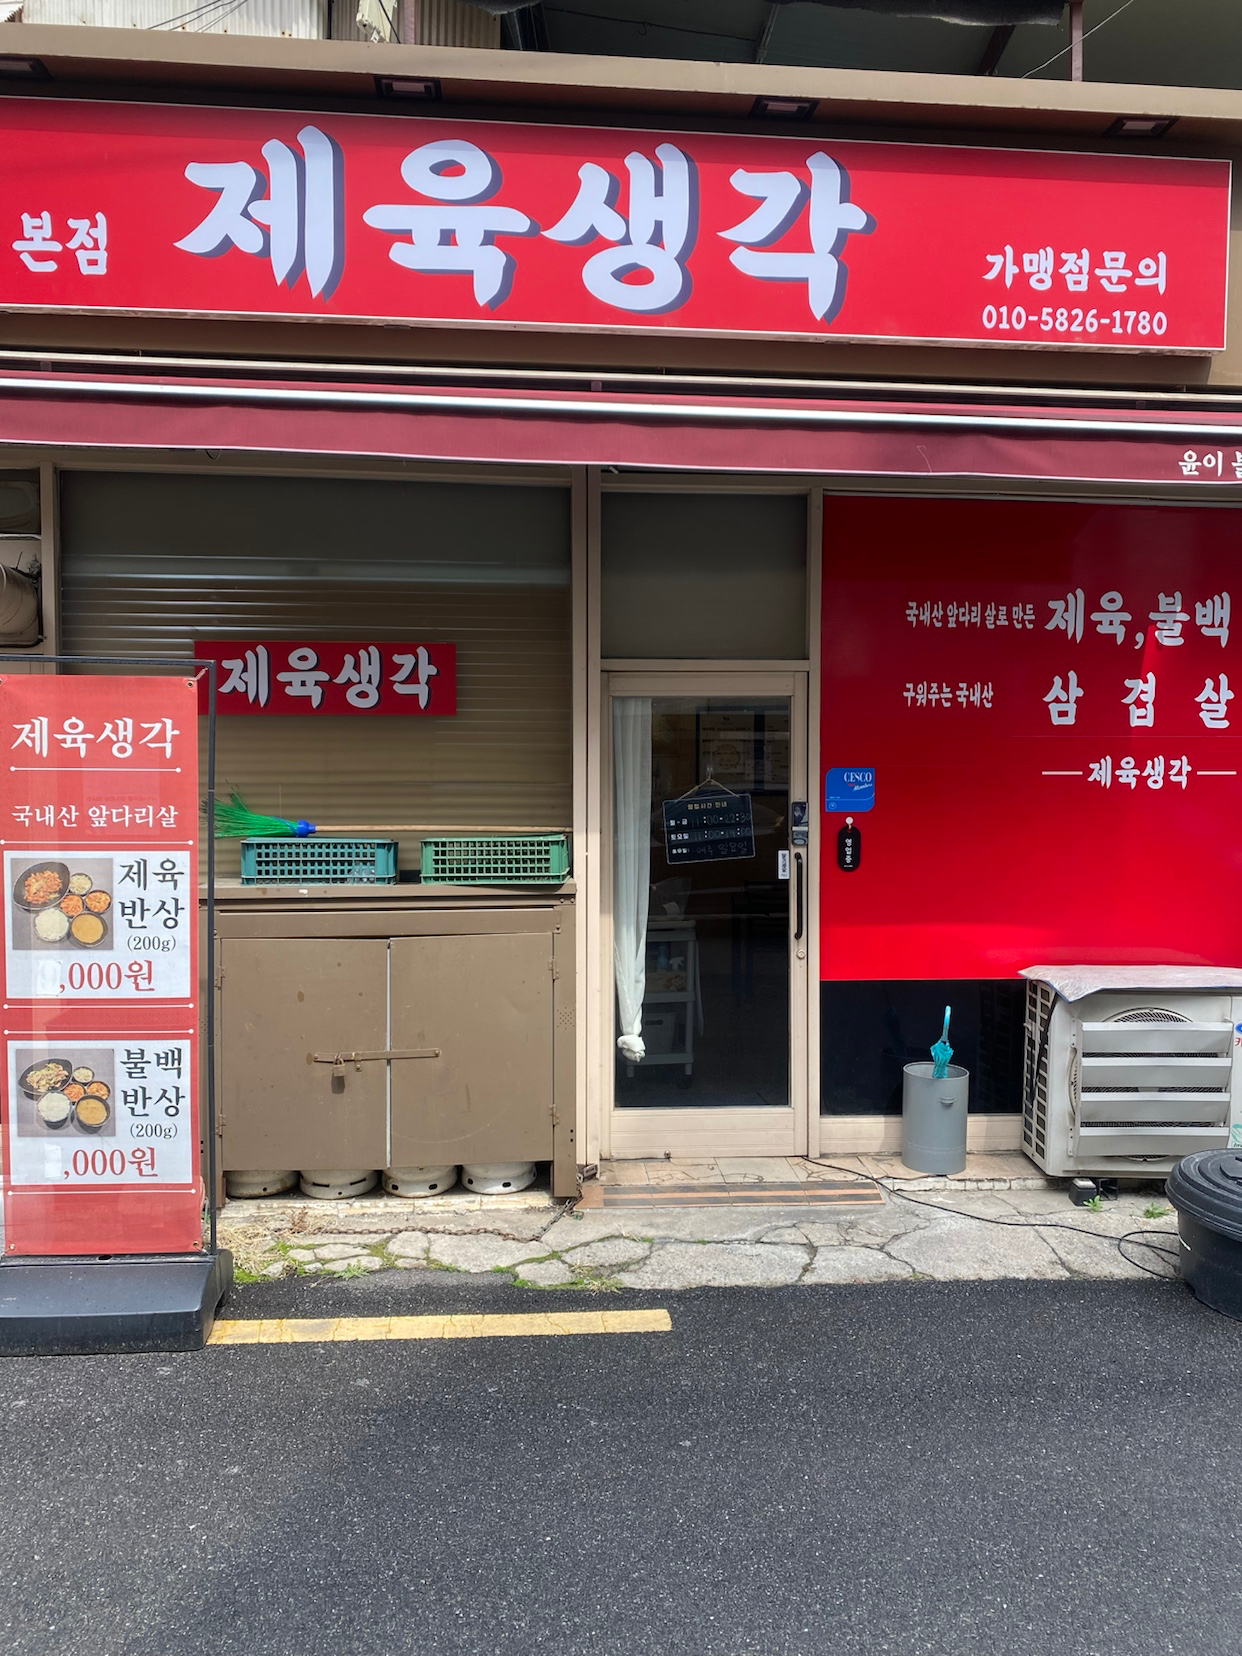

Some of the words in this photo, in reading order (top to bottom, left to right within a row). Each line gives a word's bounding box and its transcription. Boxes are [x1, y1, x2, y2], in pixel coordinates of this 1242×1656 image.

[173, 124, 871, 323] 제육생각
[12, 211, 108, 275] 본점
[982, 244, 1167, 295] 가맹점문의
[982, 304, 1167, 335] 010-5826-1780
[1178, 449, 1223, 477] 윤이
[905, 601, 943, 628] 국내산
[947, 601, 981, 628] 앞다리
[985, 601, 1008, 629] 살로
[1012, 602, 1036, 629] 만든
[217, 644, 438, 710] 제육생각
[903, 681, 952, 707] 구워주는
[956, 681, 994, 708] 국내산
[11, 716, 180, 759] 제육생각
[843, 771, 873, 783] CESCO
[1087, 755, 1192, 790] 제육생각
[11, 805, 80, 828] 국내산
[88, 805, 179, 828] 앞다리살
[118, 858, 185, 891] 제육
[118, 897, 185, 930] 반상
[127, 935, 176, 953] (200g)
[120, 1047, 182, 1080] 불백
[120, 1086, 186, 1117] 반상
[130, 1123, 178, 1140] (200g)
